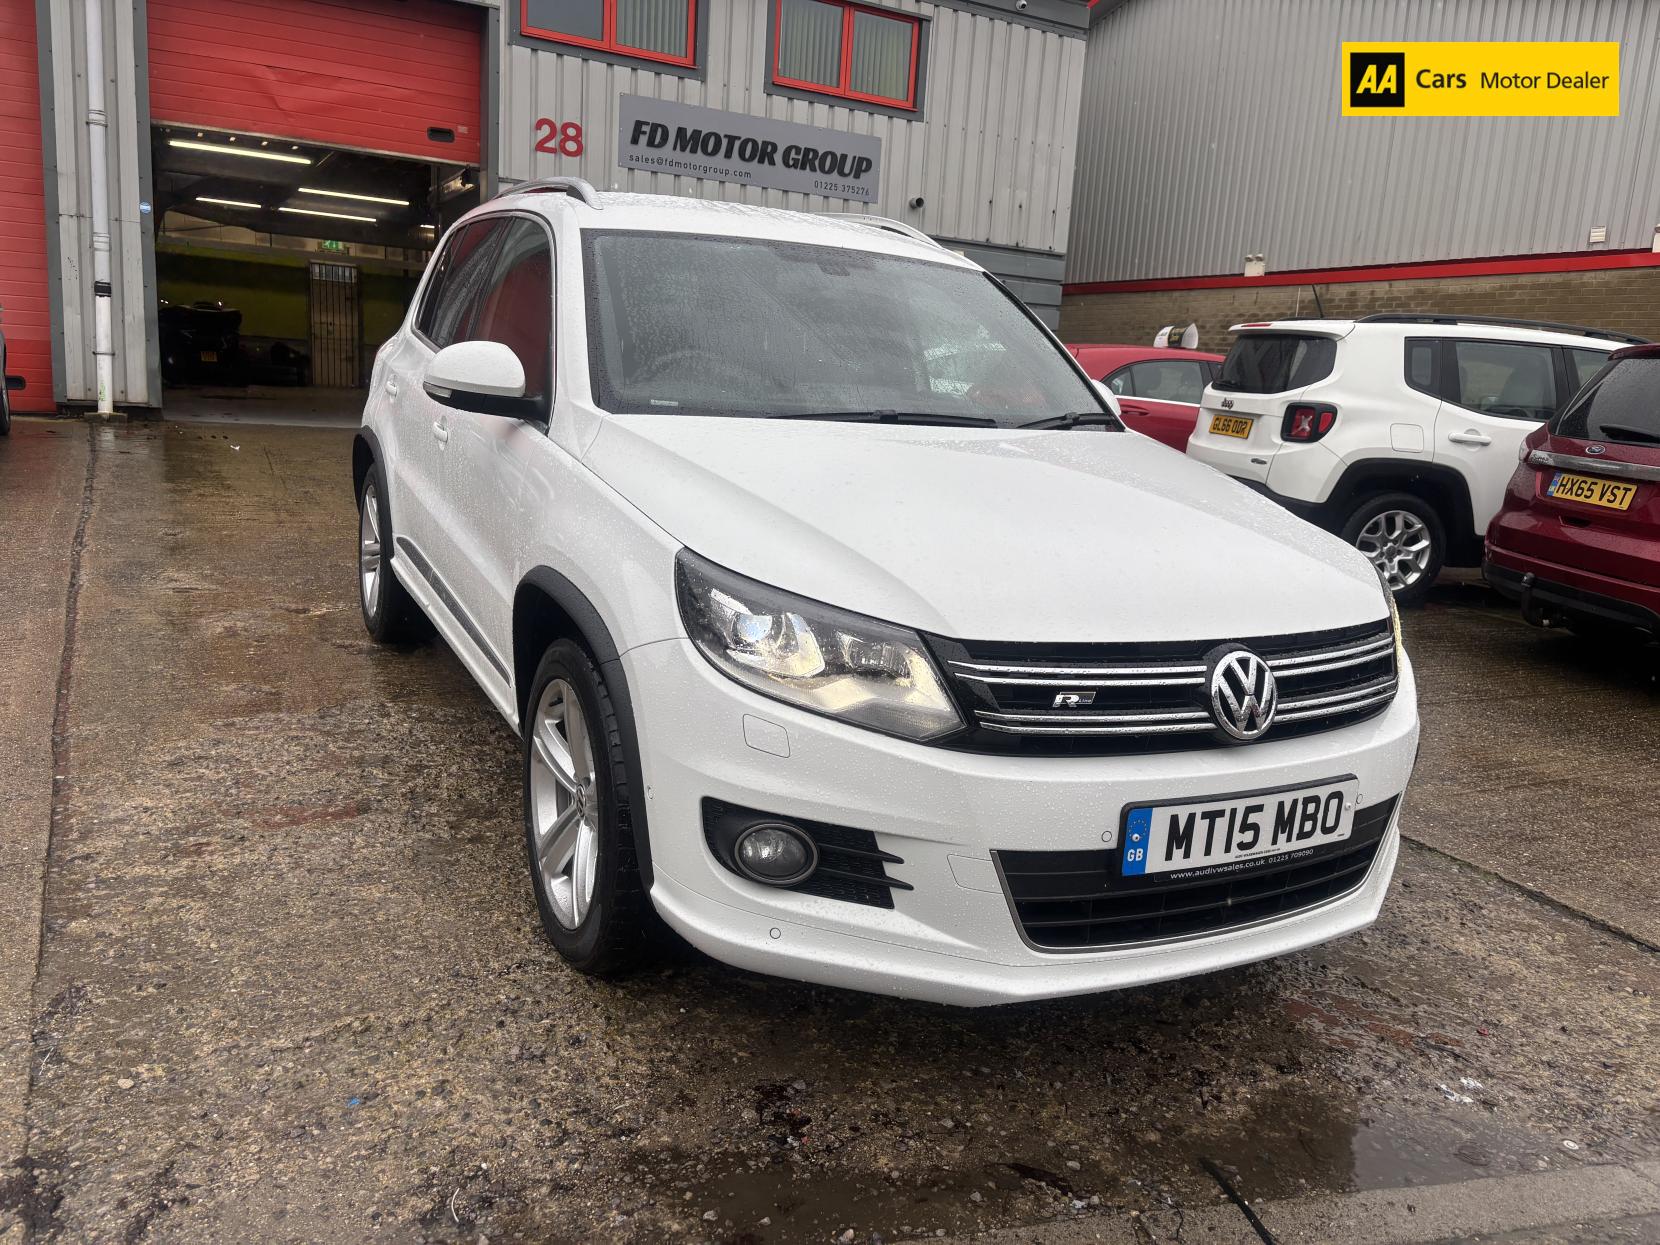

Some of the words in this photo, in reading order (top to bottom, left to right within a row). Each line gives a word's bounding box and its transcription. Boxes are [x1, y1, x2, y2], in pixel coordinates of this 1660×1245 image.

[534, 117, 583, 158] 28
[630, 119, 669, 150] FD
[672, 129, 778, 167] MOTOR
[781, 145, 873, 180] GROUP
[628, 153, 752, 179] sales@fdmotorgroup.com
[814, 180, 838, 191] 01225
[1555, 476, 1598, 499] HX65
[1598, 482, 1632, 506] VST
[1164, 804, 1264, 862] MT15
[1271, 791, 1343, 845] MBO
[1127, 848, 1144, 862] GB
[1268, 854, 1289, 864] 01225
